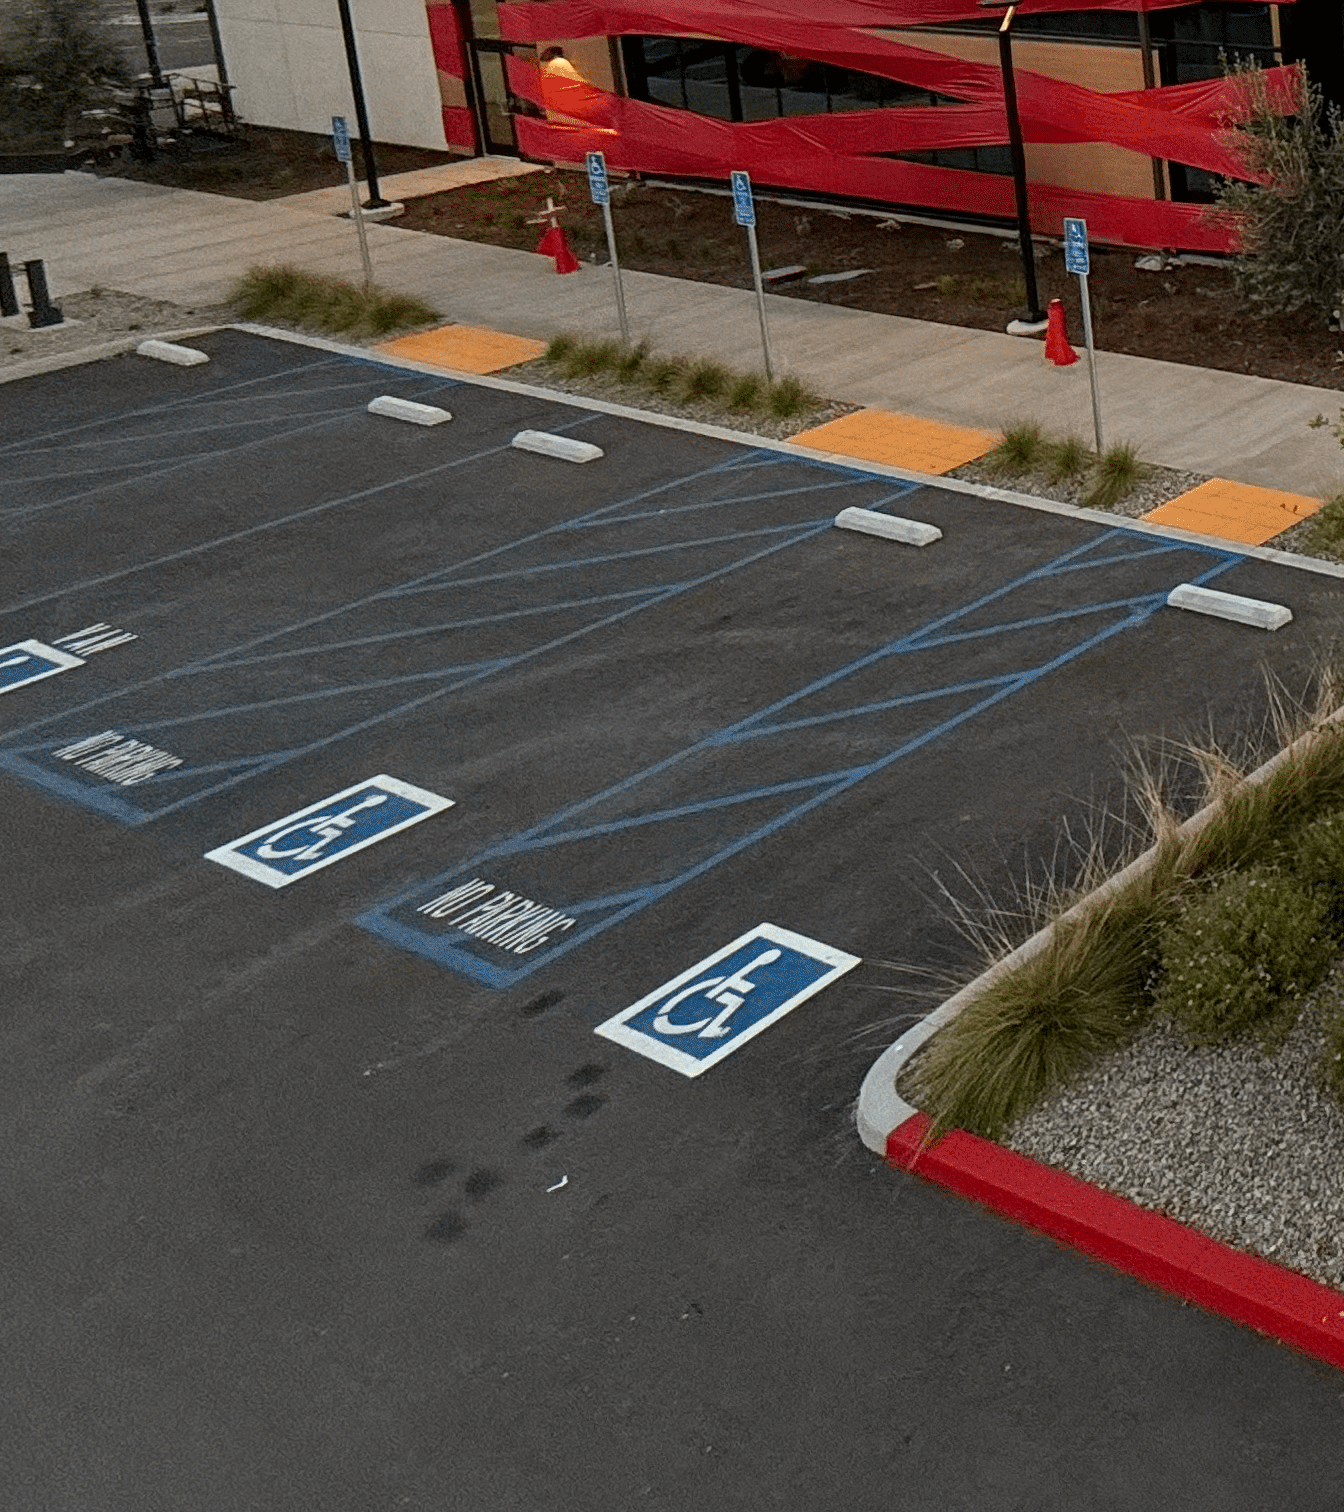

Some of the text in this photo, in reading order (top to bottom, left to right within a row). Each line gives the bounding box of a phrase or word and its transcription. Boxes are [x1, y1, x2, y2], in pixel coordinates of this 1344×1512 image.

[51, 622, 139, 657] VAN
[51, 729, 184, 786] NO PARKING
[416, 877, 577, 954] NO PARKING
